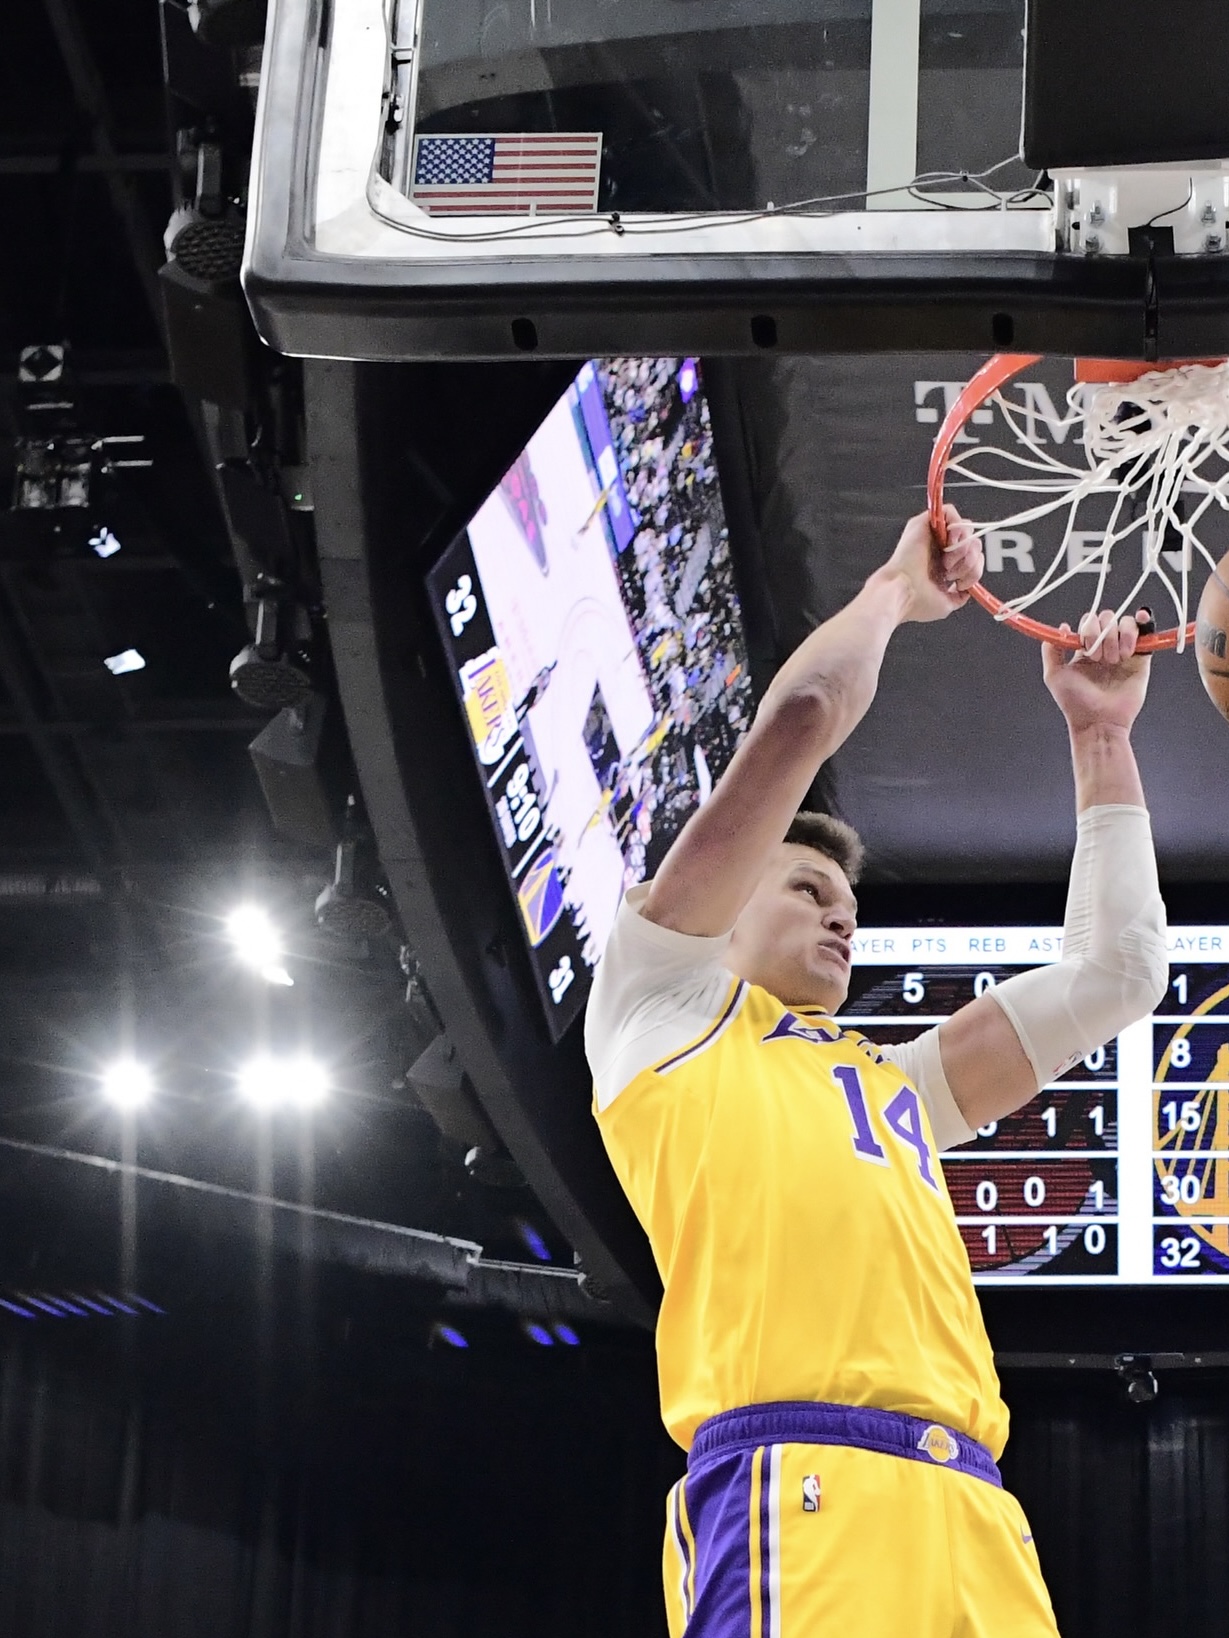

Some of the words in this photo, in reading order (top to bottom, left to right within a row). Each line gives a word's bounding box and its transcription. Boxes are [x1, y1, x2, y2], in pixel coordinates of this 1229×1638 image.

[446, 574, 477, 637] 32
[912, 938, 946, 952] PTS
[969, 938, 1006, 952] REB
[1028, 938, 1062, 951] AST
[903, 973, 925, 1003] 5
[1172, 974, 1188, 1004] 1
[1170, 1038, 1192, 1068] 8
[832, 1064, 940, 1192] 14
[1041, 1107, 1057, 1137] 1
[1089, 1105, 1104, 1136] 1
[1162, 1101, 1201, 1132] 15
[976, 1180, 998, 1212] 0
[1024, 1176, 1046, 1207] 0
[1089, 1180, 1104, 1210] 1
[1160, 1175, 1201, 1205] 30
[982, 1225, 997, 1255] 1
[1043, 1225, 1058, 1255] 1
[1084, 1224, 1106, 1255] 0
[1160, 1237, 1201, 1268] 32
